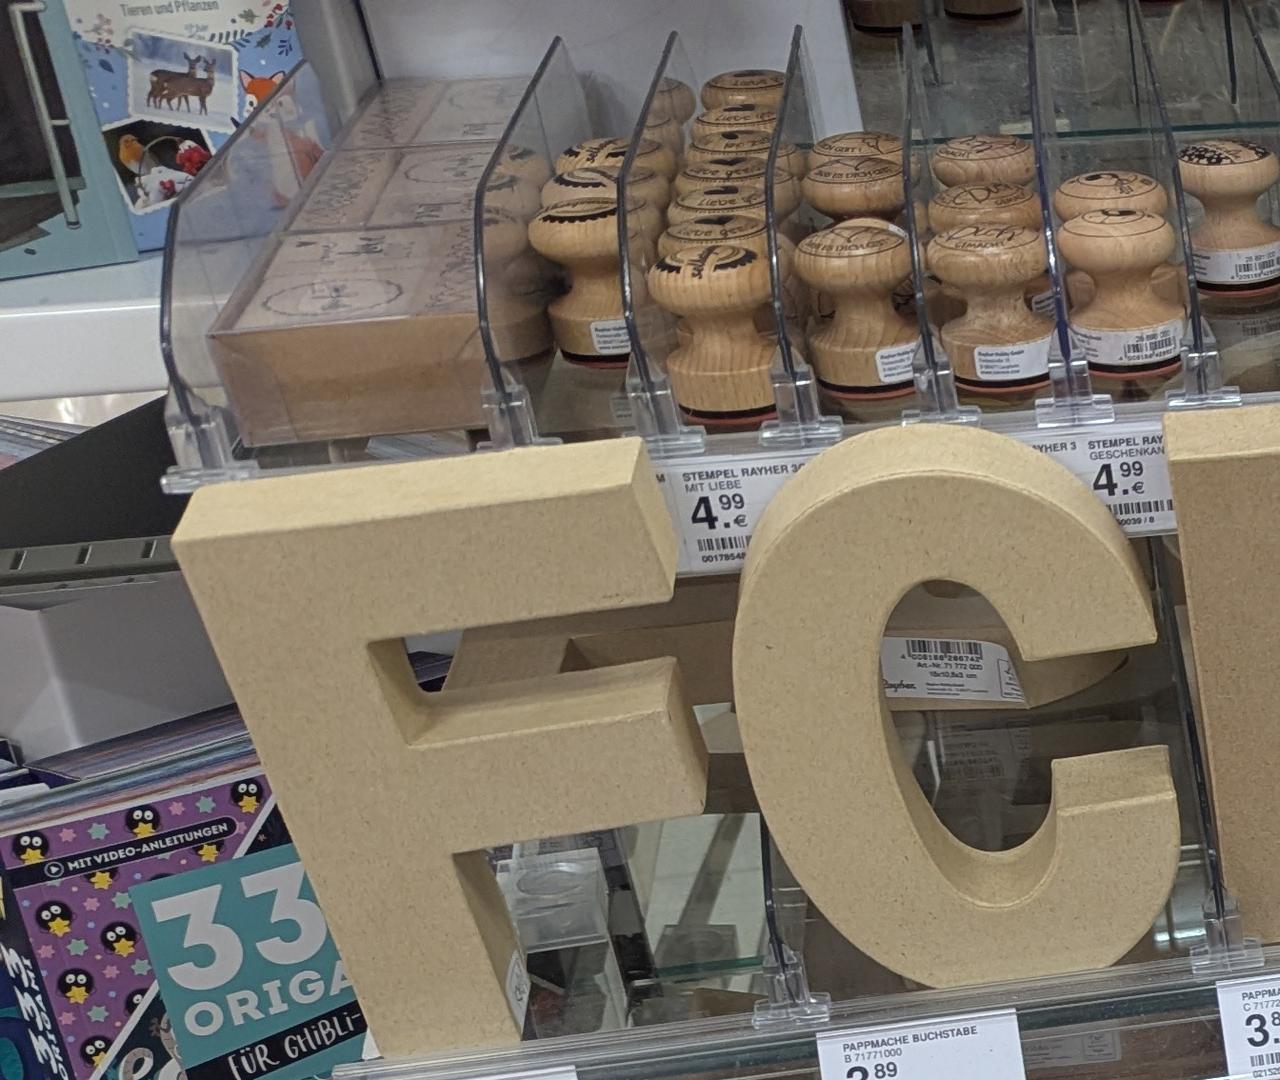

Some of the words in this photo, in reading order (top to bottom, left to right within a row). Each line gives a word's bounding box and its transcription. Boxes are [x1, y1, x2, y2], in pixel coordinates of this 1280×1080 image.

[1087, 438, 1139, 450] STEMPEL
[682, 468, 738, 482] STEMPEL
[741, 466, 789, 477] RAYHER
[685, 483, 703, 493] MIT
[709, 480, 742, 491] LIEBE
[67, 854, 95, 873] MIT
[95, 821, 229, 866] VIDEO-ANLEITUNGEN
[842, 1036, 910, 1053] PAPPMACHE
[912, 1026, 978, 1043] BUCHSTABE
